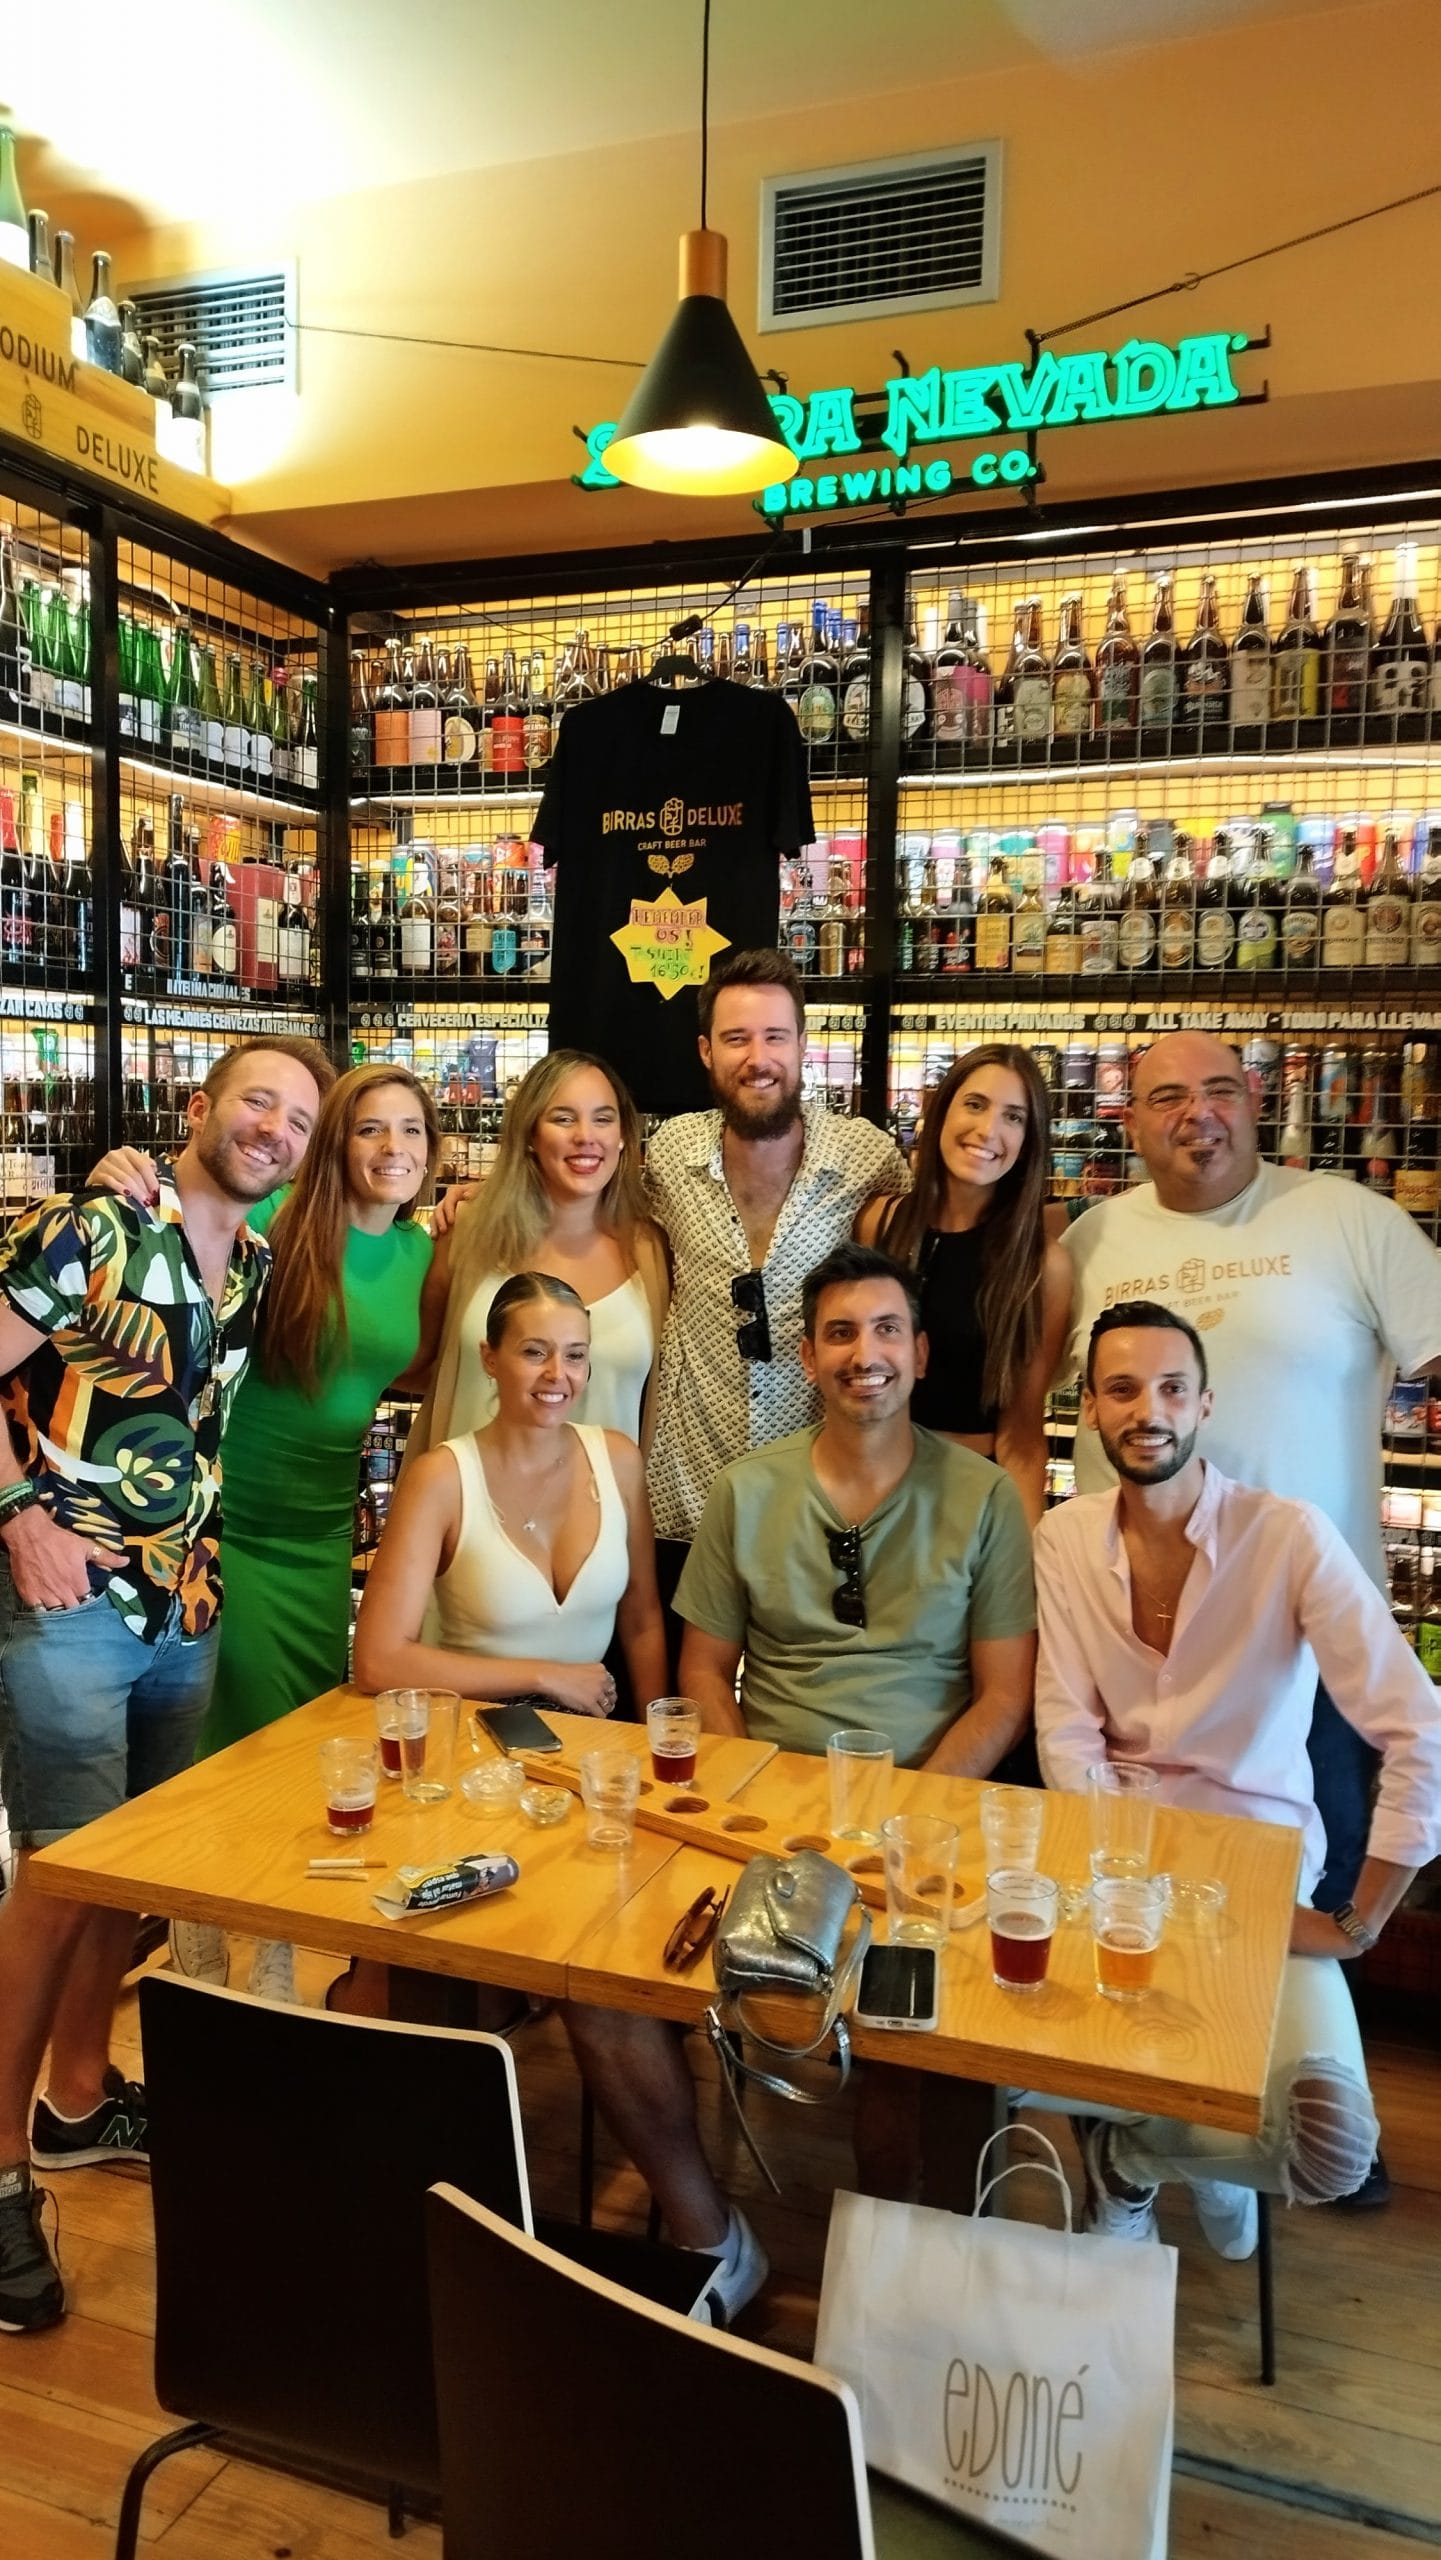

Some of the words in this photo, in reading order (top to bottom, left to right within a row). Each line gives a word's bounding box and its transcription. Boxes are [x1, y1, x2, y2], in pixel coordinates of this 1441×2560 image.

[76, 425, 159, 494] DELUXE
[762, 459, 951, 513] BREWING
[971, 449, 1037, 485] CO.
[602, 809, 656, 835] BIRRAS
[687, 803, 743, 826] DELUXE
[638, 840, 663, 851] CRAFT
[664, 839, 687, 849] BEER
[688, 838, 707, 848] BAR
[166, 978, 251, 1001] INTERNACIONALES
[25, 1000, 63, 1020] CATAS
[397, 1013, 474, 1028] CERVECERIA
[934, 1013, 1006, 1030] EVENTOS
[1006, 1013, 1086, 1030] PRIVADOS
[1144, 1012, 1179, 1030] ALL
[1178, 1012, 1223, 1030] TAKE
[1326, 1011, 1377, 1029] PARA
[144, 1008, 166, 1026] LAS
[166, 1009, 212, 1030] MEJORES
[213, 1013, 260, 1033] CERVEZAS
[261, 1018, 311, 1038] ARTESANAS
[1104, 1274, 1171, 1307] BIRRAS
[1211, 1254, 1292, 1281] DELUXE
